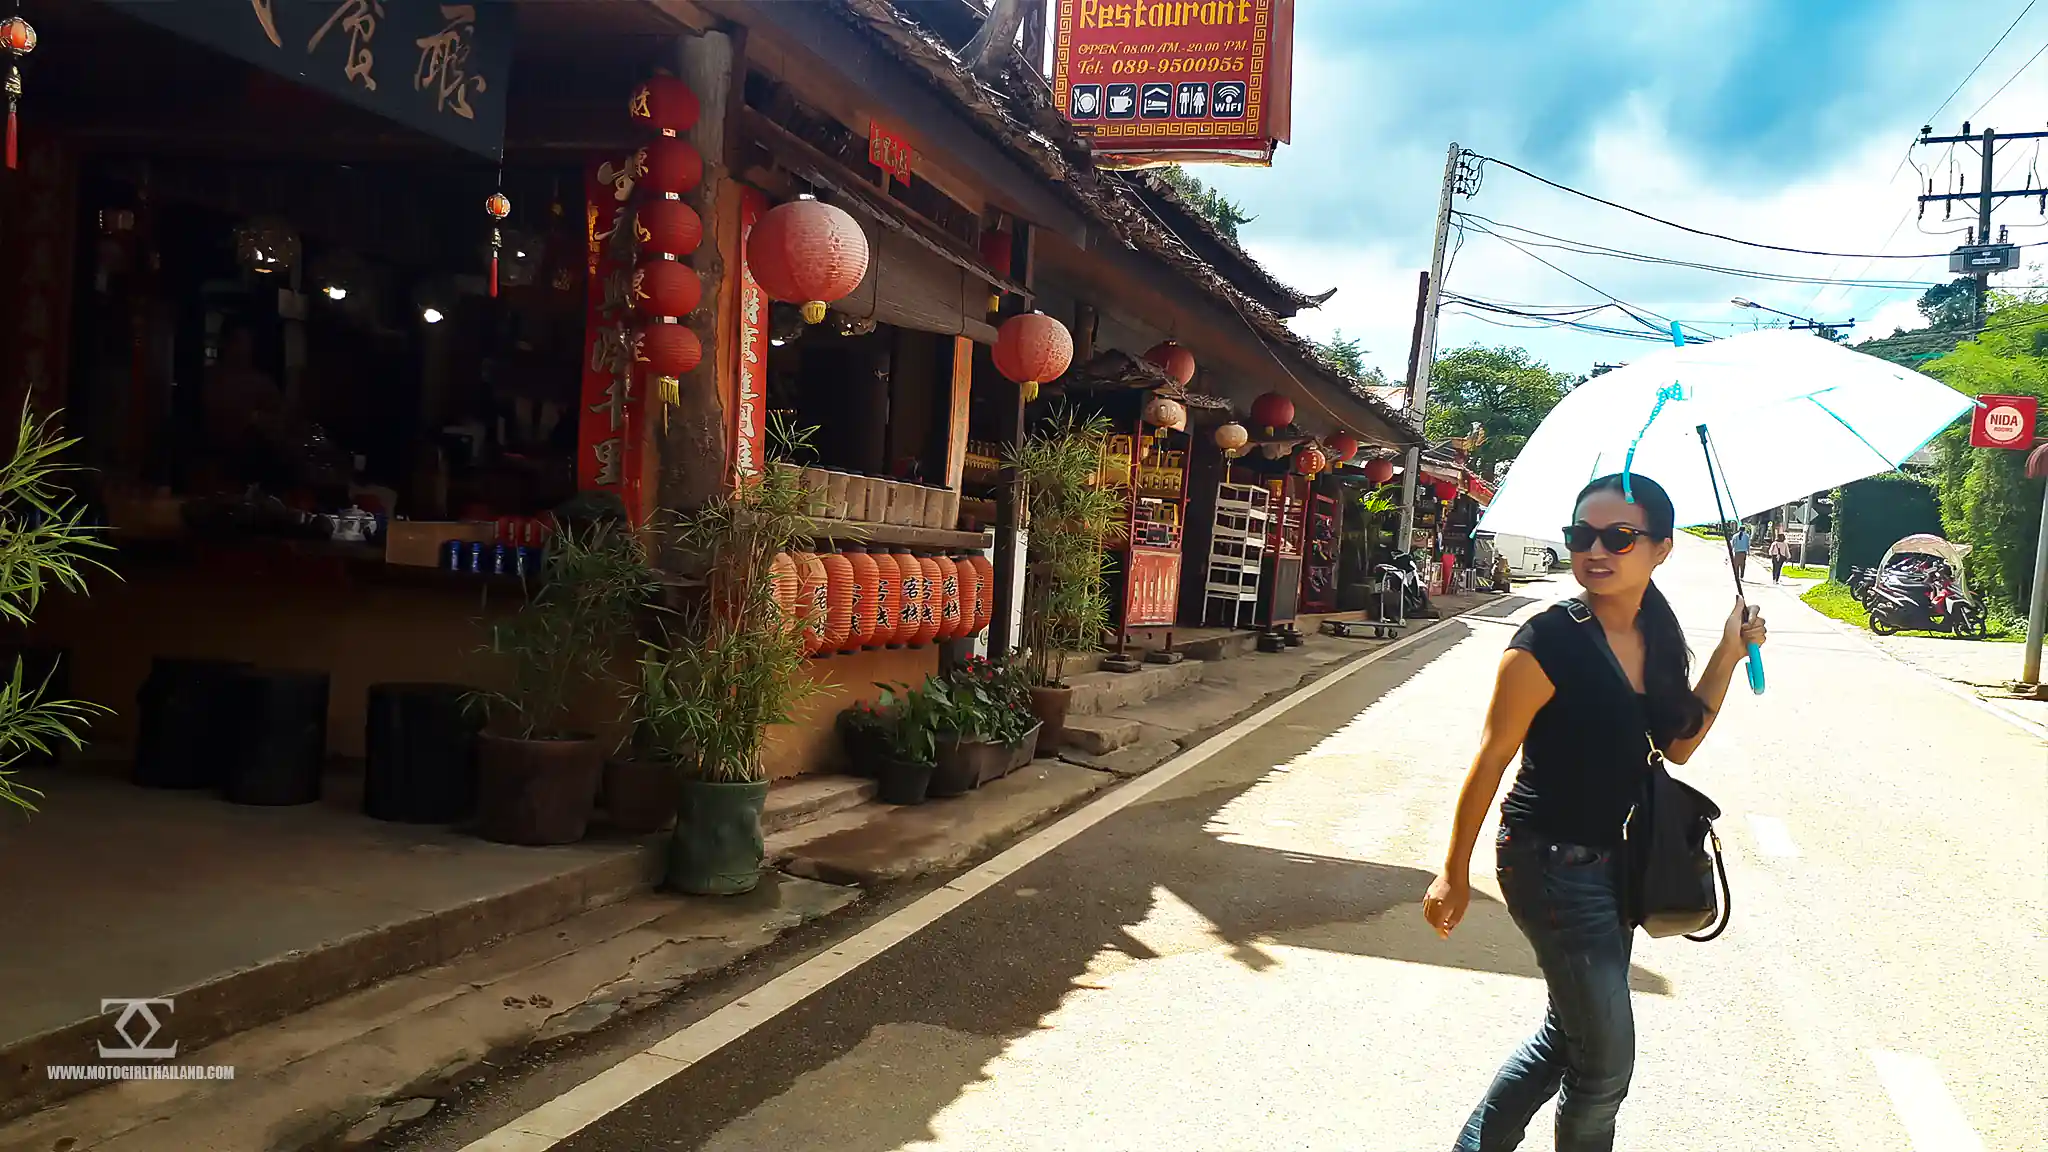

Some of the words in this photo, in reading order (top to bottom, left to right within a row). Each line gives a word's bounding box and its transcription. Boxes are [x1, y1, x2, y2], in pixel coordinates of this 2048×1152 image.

[1079, 0, 1252, 29] Restaurant
[1078, 41, 1122, 55] OPEN
[1123, 44, 1155, 55] 08.00
[1224, 40, 1249, 52] PM.
[1077, 55, 1104, 75] Tel:
[1111, 56, 1245, 75] 089-9500955
[1990, 414, 2018, 426] NIDA
